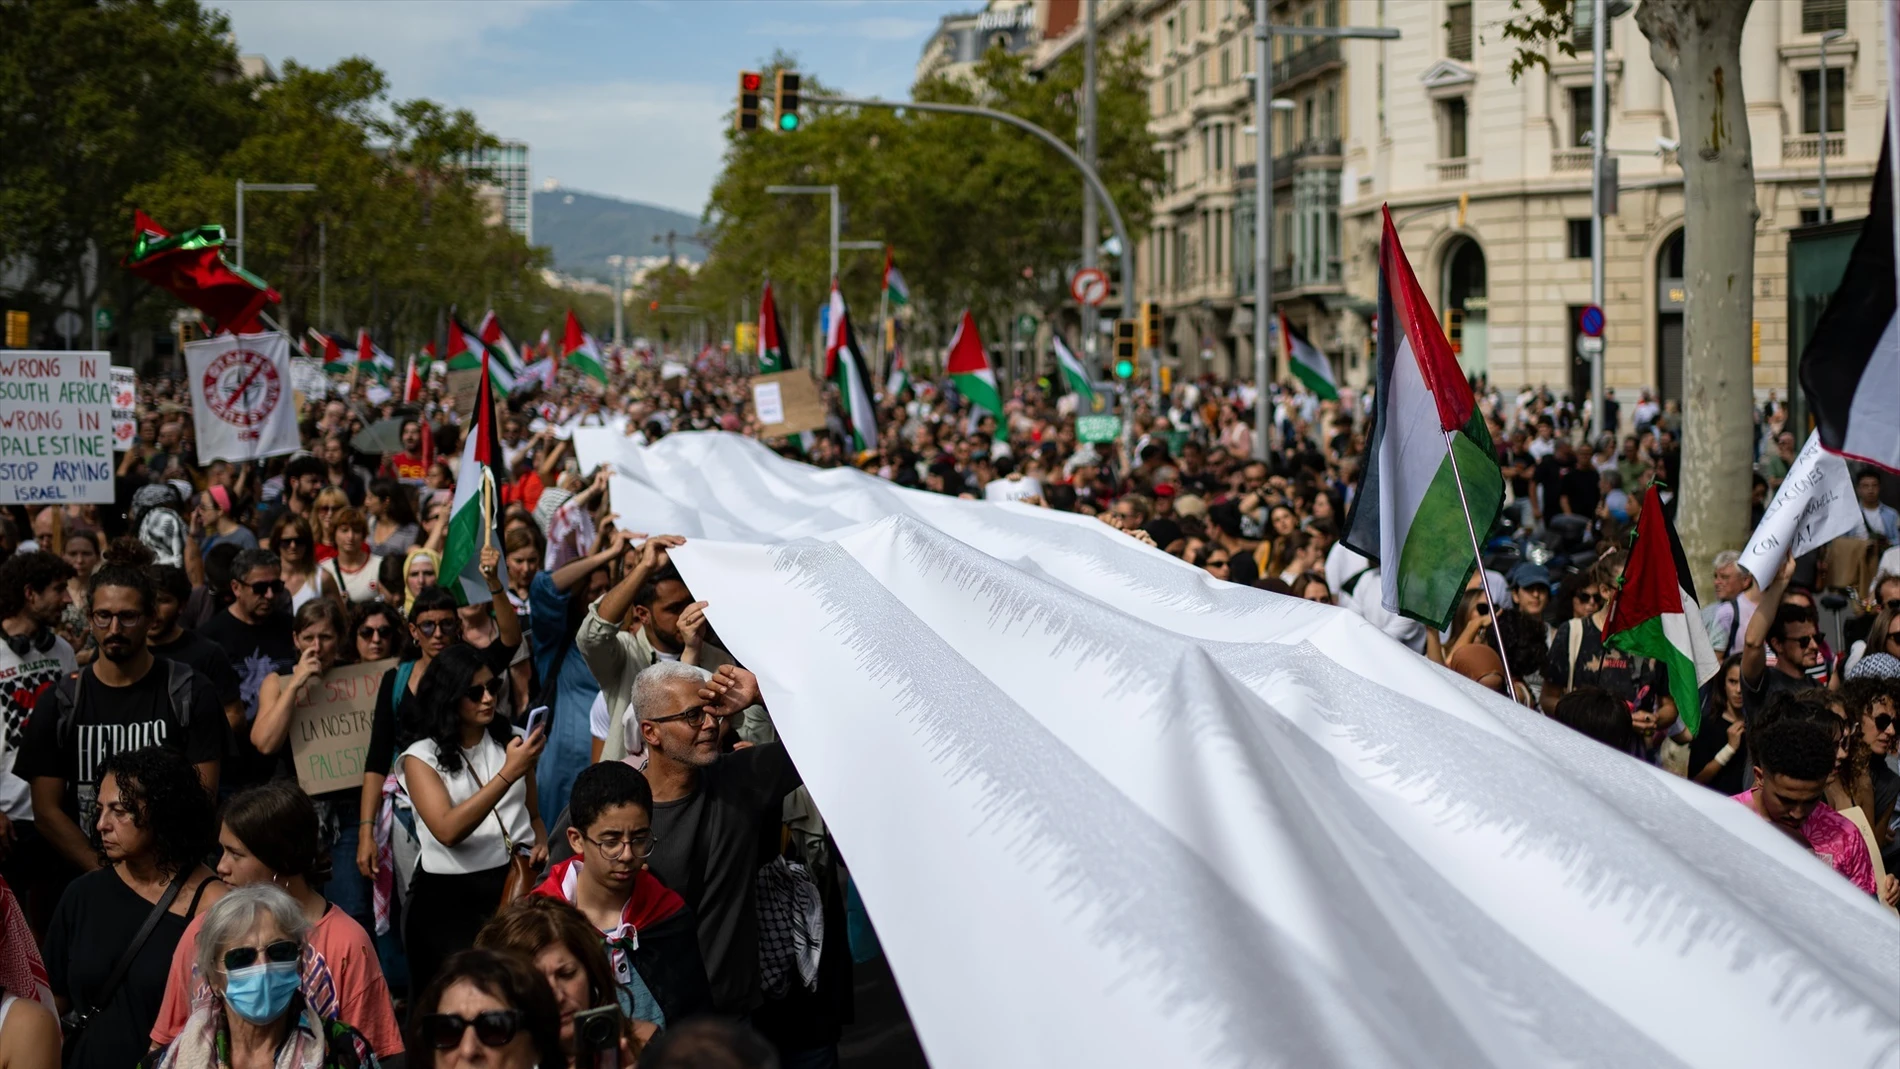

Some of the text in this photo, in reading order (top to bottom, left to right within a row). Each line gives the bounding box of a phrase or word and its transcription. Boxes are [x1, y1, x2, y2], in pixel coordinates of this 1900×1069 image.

[0, 358, 61, 378] WRONG
[80, 356, 96, 378] IN
[0, 382, 49, 403] SOUTH
[59, 380, 111, 404] AFRICA
[0, 410, 62, 432] WRONG
[78, 408, 99, 431] IN
[1, 434, 105, 457] PALESTINE
[0, 460, 110, 483] STOP ARMING
[14, 485, 67, 500] ISRAEL
[18, 659, 61, 673] PALESTINE
[324, 676, 358, 704] SEU
[301, 720, 319, 742] LA
